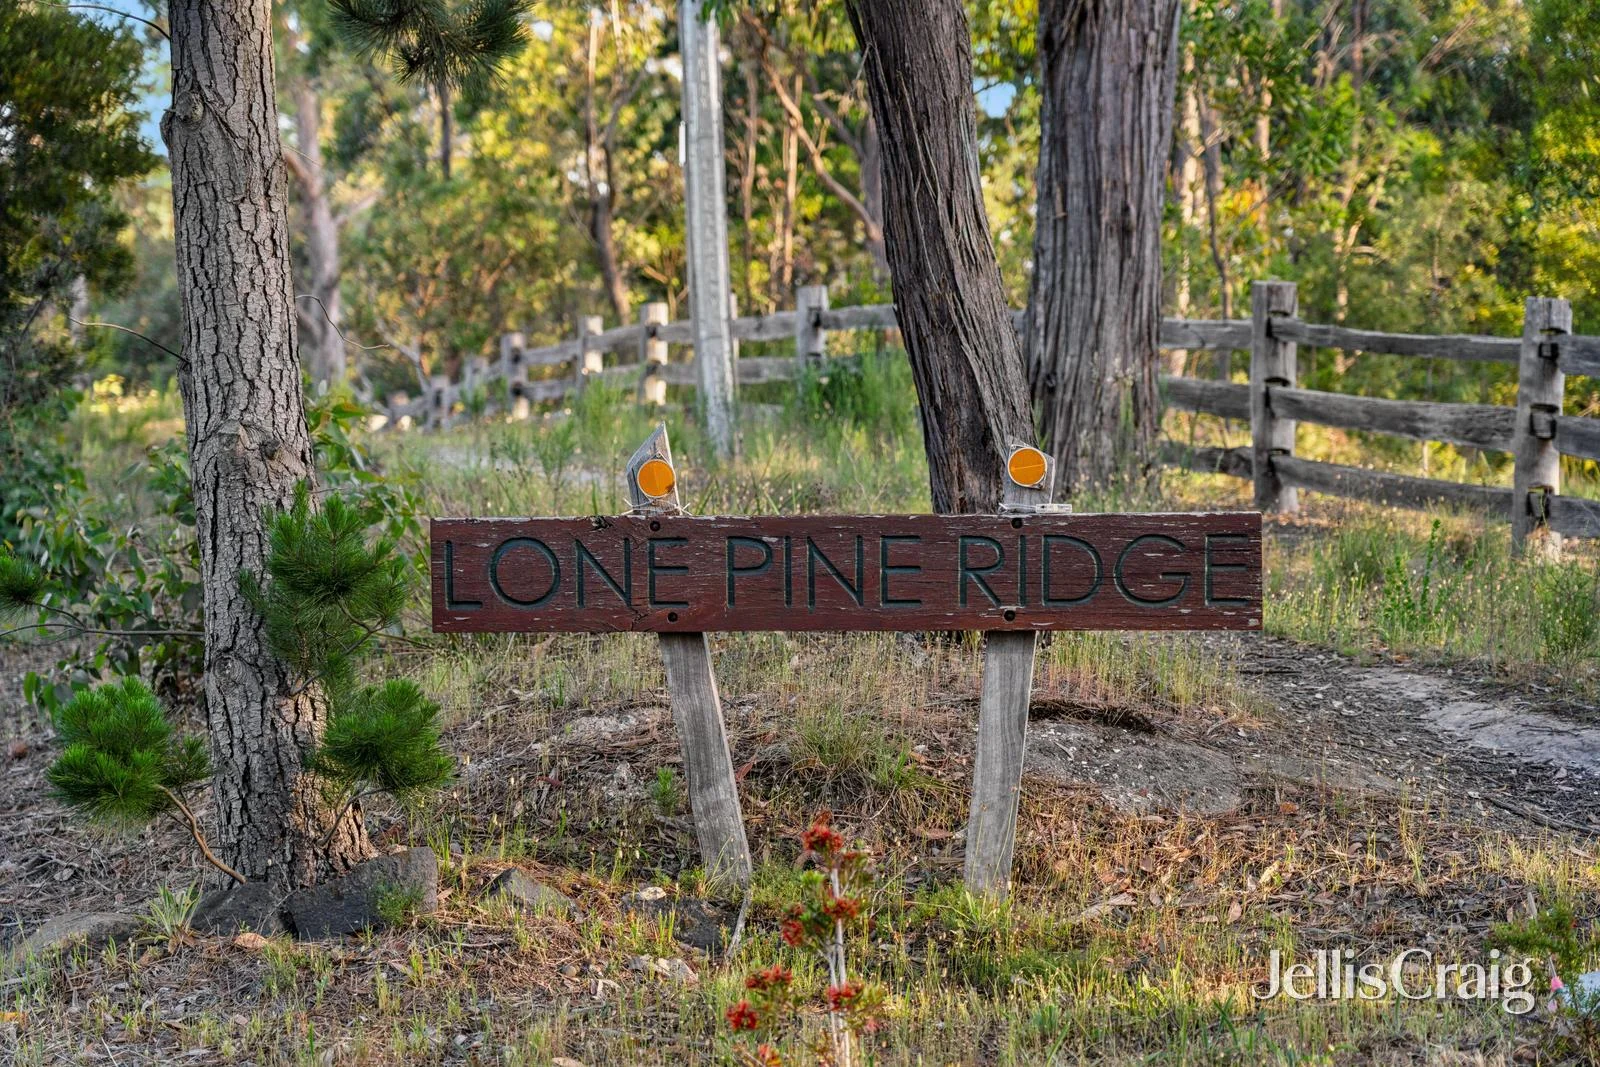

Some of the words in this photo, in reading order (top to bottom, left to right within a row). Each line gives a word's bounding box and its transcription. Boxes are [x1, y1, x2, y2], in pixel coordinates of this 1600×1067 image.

[444, 536, 690, 610] LONE
[726, 534, 923, 612] PINE
[957, 533, 1251, 609] RIDGE
